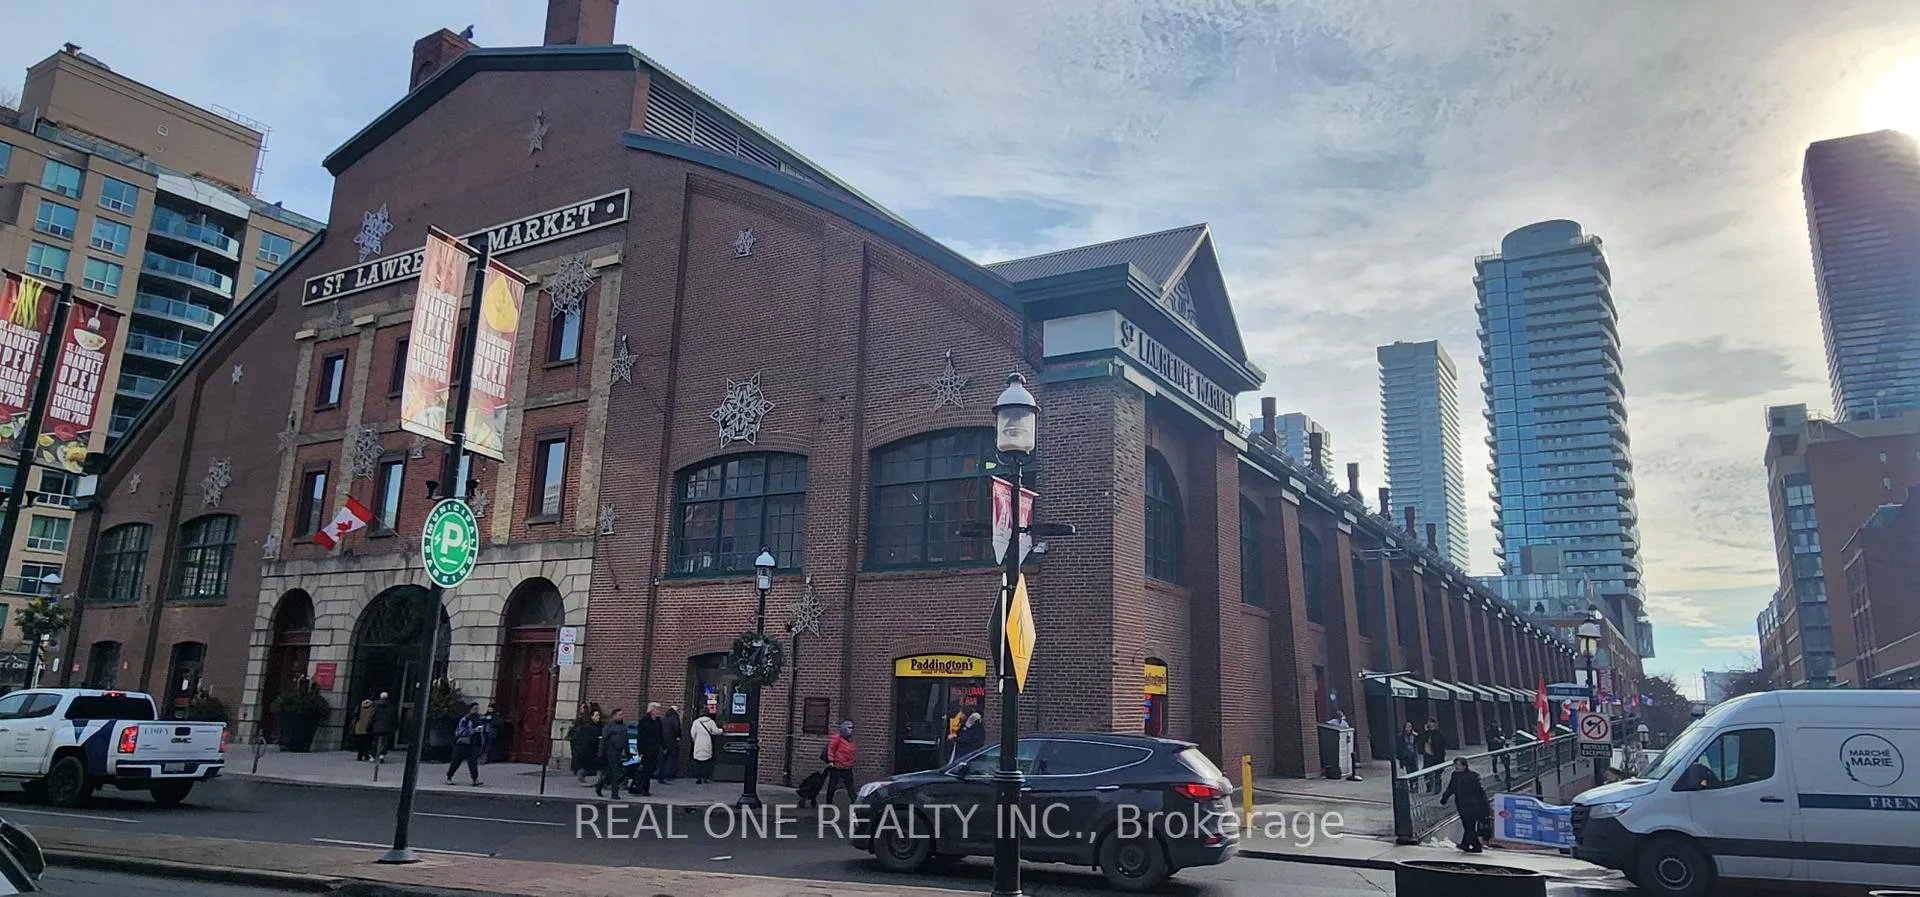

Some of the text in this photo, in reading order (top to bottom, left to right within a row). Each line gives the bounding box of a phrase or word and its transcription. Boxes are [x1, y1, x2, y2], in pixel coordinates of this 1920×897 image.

[323, 274, 345, 296] ST
[488, 203, 595, 251] MARKET
[0, 345, 35, 373] PEN
[63, 351, 103, 375] MARKET
[59, 365, 100, 392] OPEN
[1139, 332, 1194, 394] LAWRENCE
[1196, 376, 1232, 420] MARKET
[52, 394, 92, 415] EVENINGS
[56, 382, 95, 404] WEEKDAY
[50, 406, 89, 426] UNTIL 7PM
[427, 504, 475, 544] MUNICIPAL
[441, 521, 463, 554] P
[911, 658, 973, 674] Paddington's
[1851, 757, 1894, 767] MARIE
[1869, 797, 1918, 808] FREN
